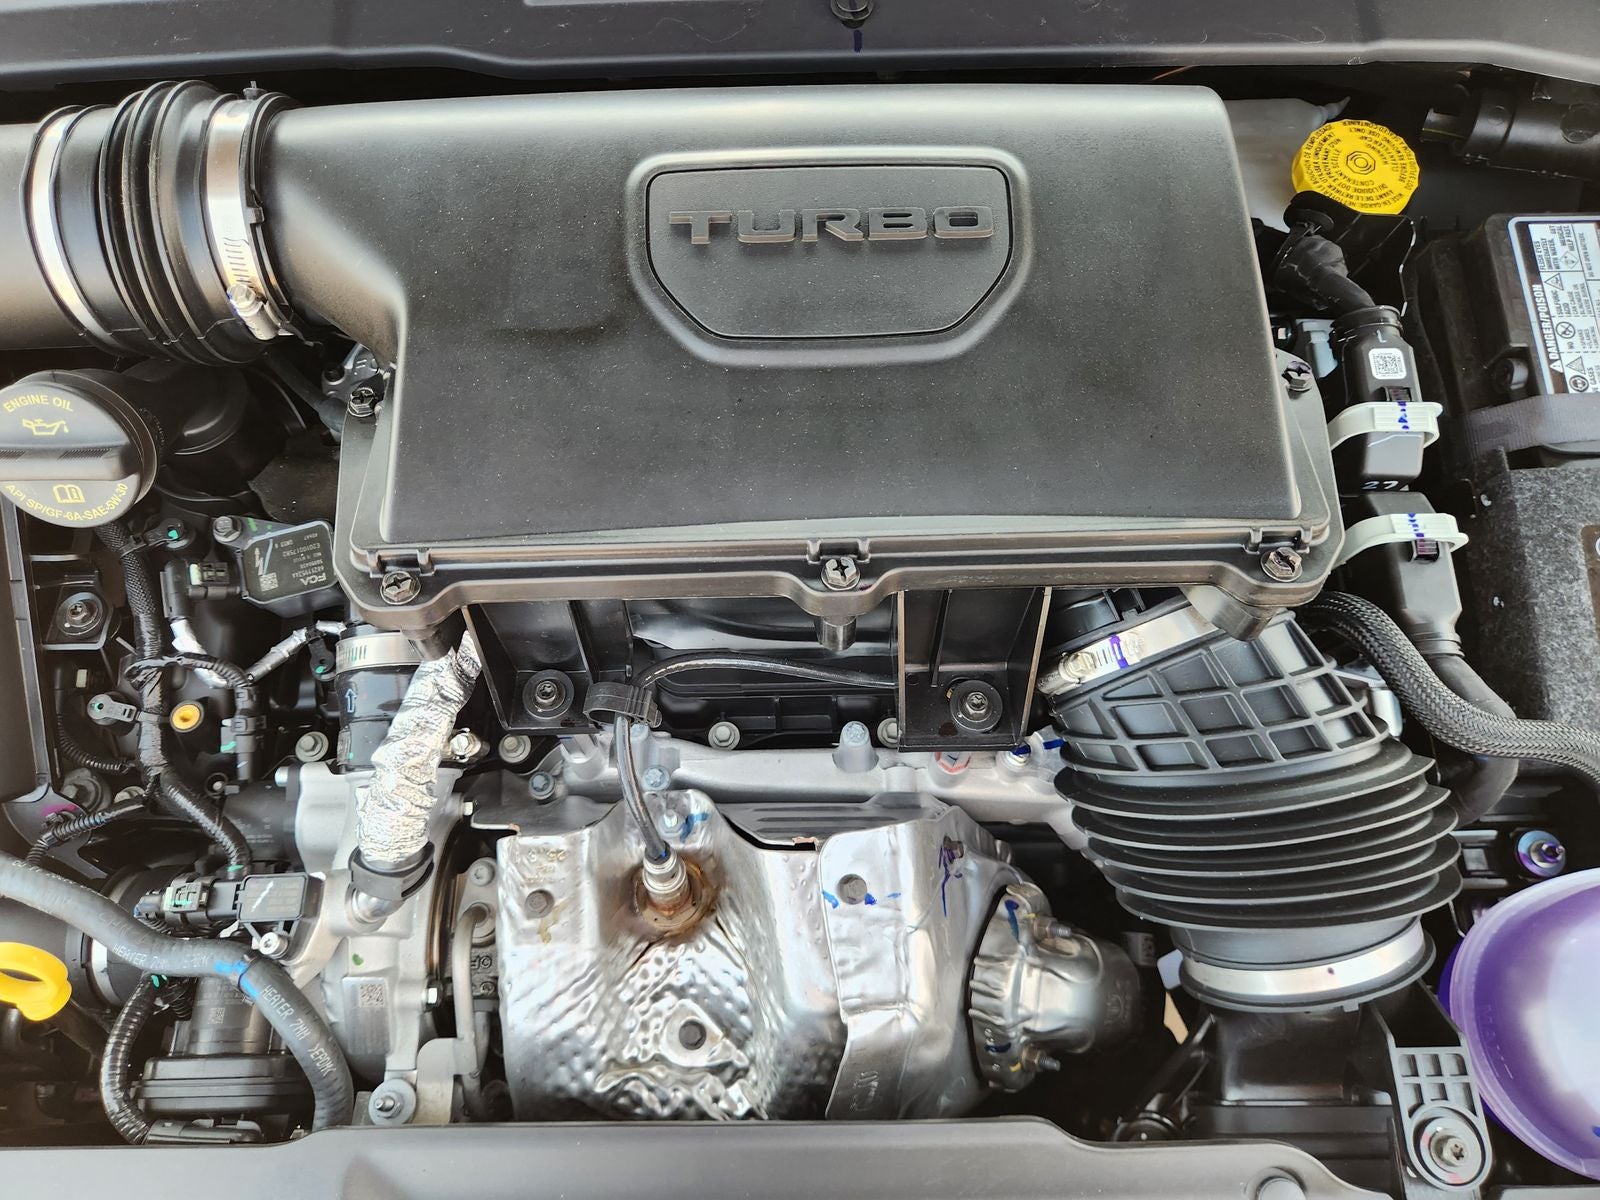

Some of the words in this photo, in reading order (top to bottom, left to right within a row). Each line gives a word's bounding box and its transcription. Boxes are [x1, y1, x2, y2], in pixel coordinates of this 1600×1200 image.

[1342, 121, 1377, 130] CONTAINER
[1398, 163, 1407, 182] BEFORE
[1337, 182, 1351, 191] DOT
[1375, 190, 1394, 201] AVANT
[1391, 193, 1404, 203] MISE
[669, 206, 993, 244] TURBO
[1556, 226, 1566, 246] MEDICAL
[1534, 241, 1542, 253] EYES
[1566, 239, 1575, 251] HELP
[1540, 238, 1553, 270] IMMEDIATELY
[1537, 255, 1546, 270] FLUSH
[1552, 257, 1561, 269] WITH
[1551, 291, 1563, 315] SULFURIC
[1567, 292, 1575, 305] CAUSE
[1562, 303, 1571, 315] ACID
[1531, 285, 1559, 360] DANGER/POISON
[1567, 342, 1575, 350] NO
[1586, 367, 1597, 385] GASES
[3, 394, 49, 412] ENGINE
[52, 397, 74, 411] OIL
[1362, 480, 1398, 490] 27
[5, 484, 25, 501] API
[300, 573, 327, 585] FCA
[112, 943, 145, 964] HEATER
[261, 985, 294, 1019] HEATER
[289, 1018, 311, 1040] 7MM
